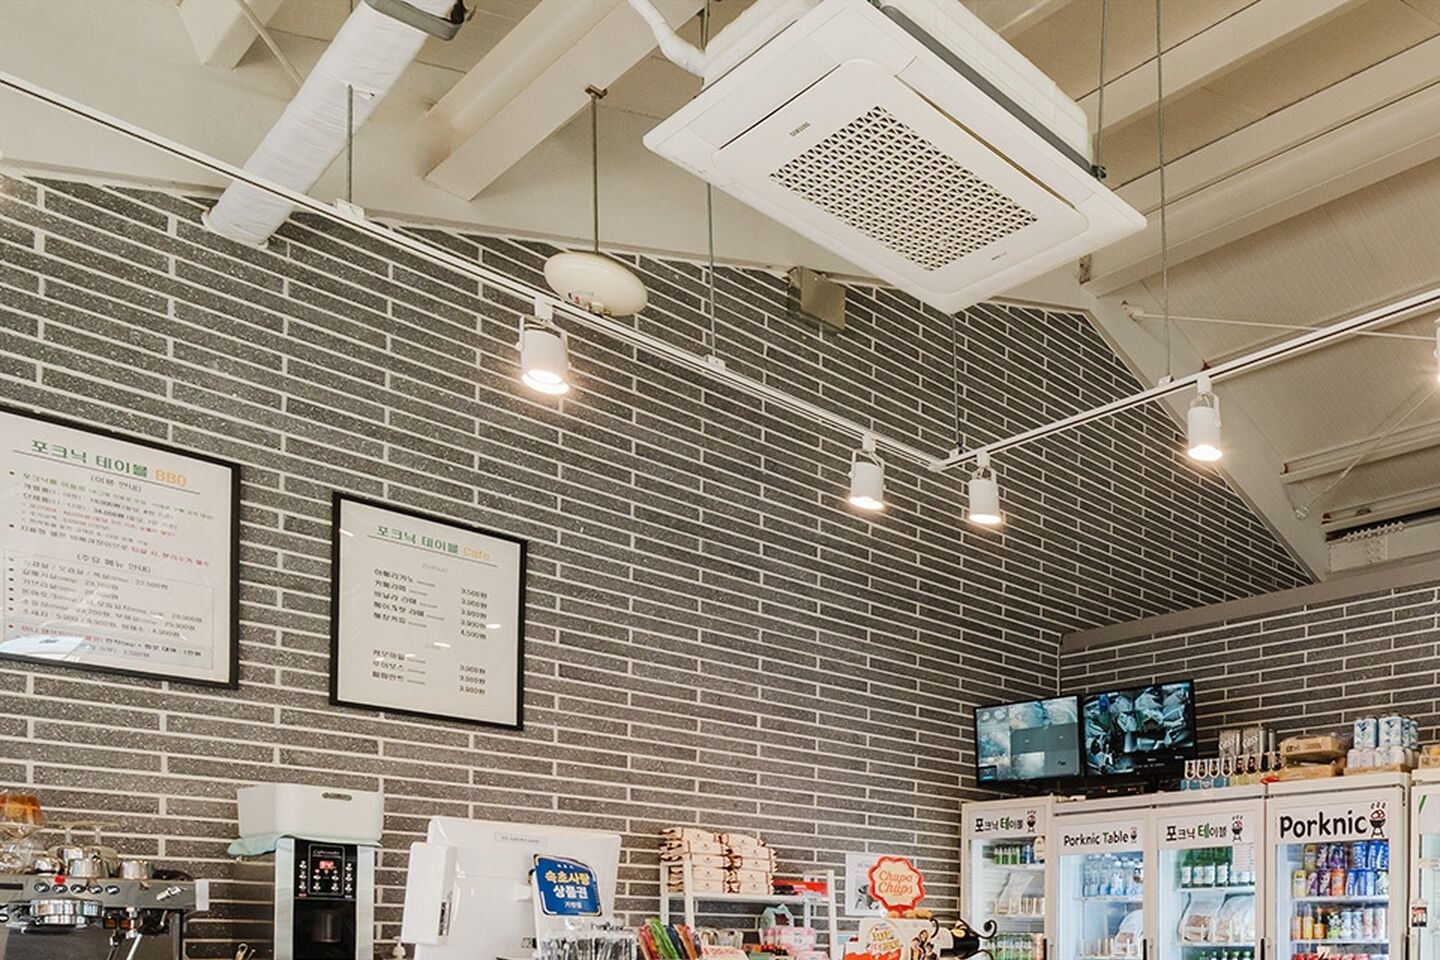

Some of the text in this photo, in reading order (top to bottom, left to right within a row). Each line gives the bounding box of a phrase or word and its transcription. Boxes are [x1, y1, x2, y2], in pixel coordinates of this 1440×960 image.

[975, 816, 1024, 833] 포크닉 테이블
[1165, 823, 1228, 841] 포크닉 테이블
[1279, 809, 1368, 839] Porknic
[1064, 831, 1129, 847] Porknic Table
[545, 869, 590, 886] 속초사랑
[878, 870, 914, 884] Chupa
[553, 885, 588, 899] 상품권
[878, 881, 915, 895] Chups
